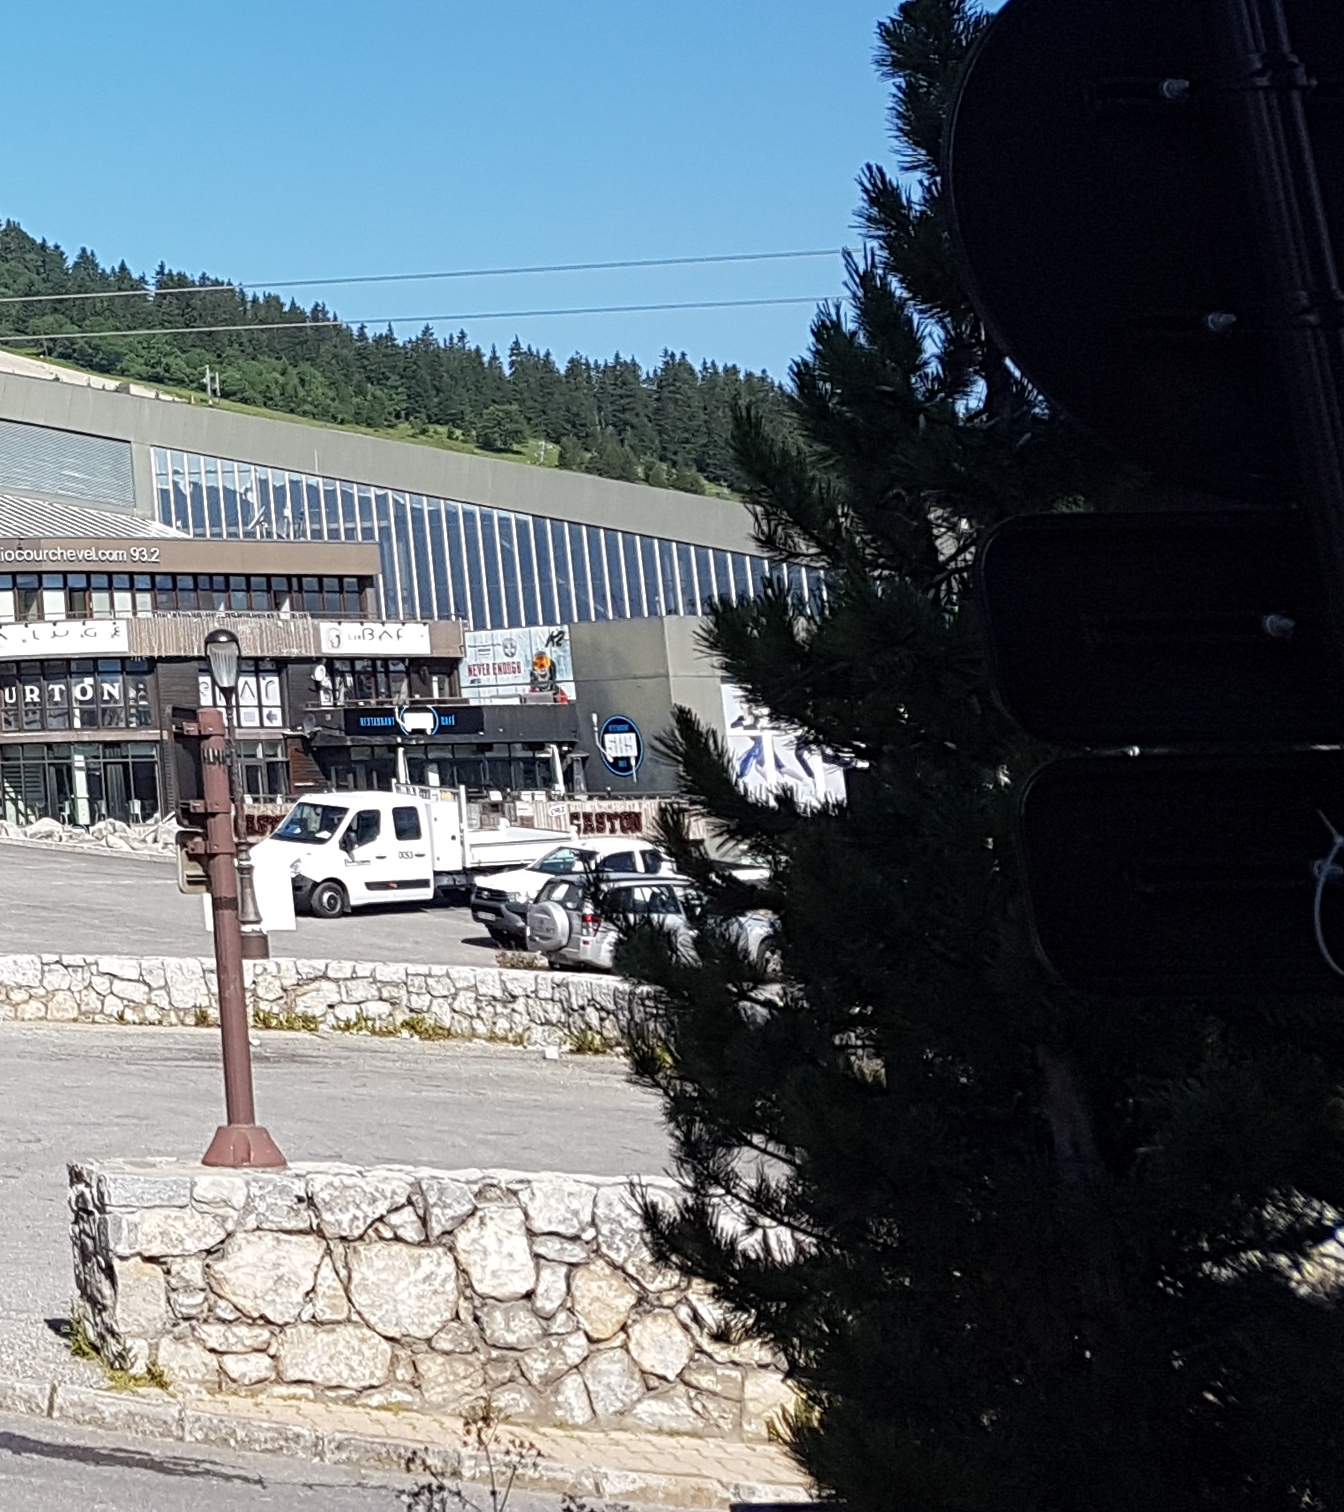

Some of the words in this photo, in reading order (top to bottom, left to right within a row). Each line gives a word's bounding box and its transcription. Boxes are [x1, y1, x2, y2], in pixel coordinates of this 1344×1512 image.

[130, 547, 161, 564] 93.2
[545, 630, 566, 648] K2
[467, 663, 490, 677] NEVER
[492, 661, 521, 676] ENOUGH
